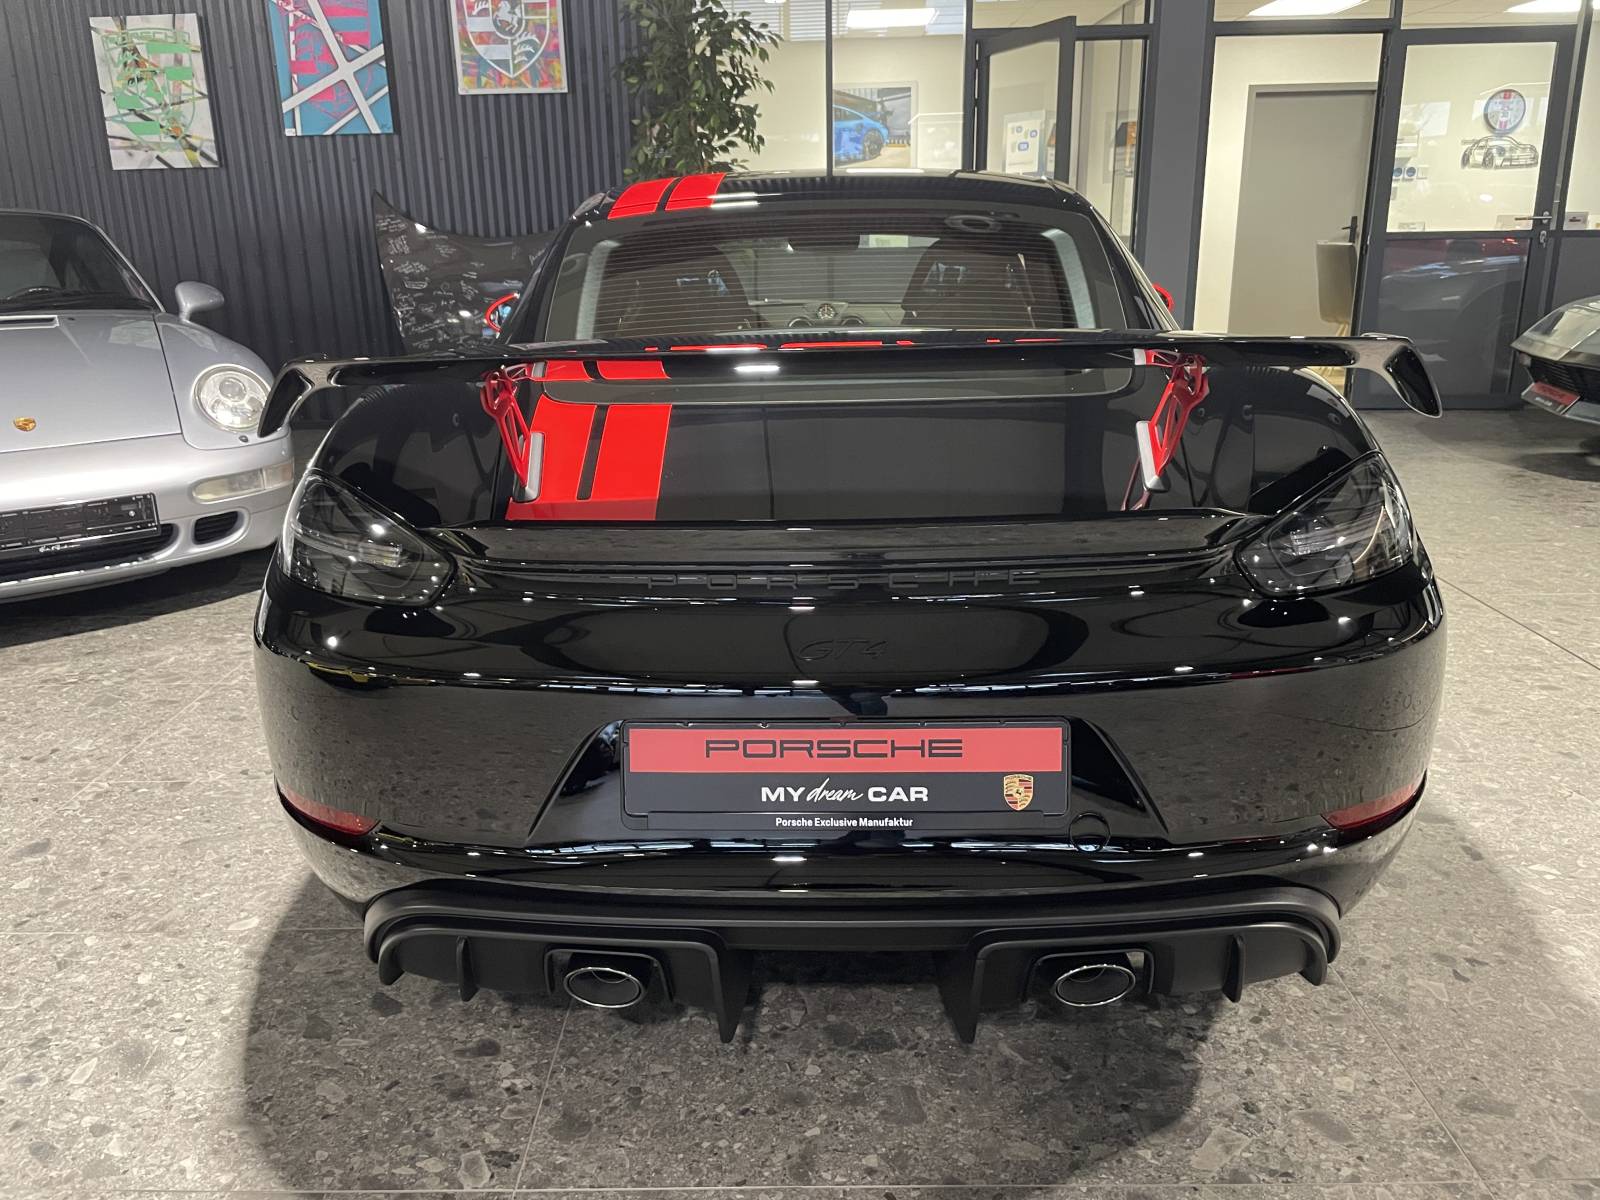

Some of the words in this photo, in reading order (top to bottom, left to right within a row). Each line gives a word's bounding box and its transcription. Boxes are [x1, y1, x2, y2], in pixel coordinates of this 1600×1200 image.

[647, 571, 1041, 590] PORSCHE
[798, 638, 888, 661] GT4
[705, 738, 963, 759] PORSCHE
[761, 786, 805, 802] MY
[806, 777, 864, 803] dream
[867, 786, 929, 802] CAR
[775, 817, 813, 828] Porsche
[814, 817, 858, 828] Exclusive
[859, 817, 914, 828] Manufaktur
